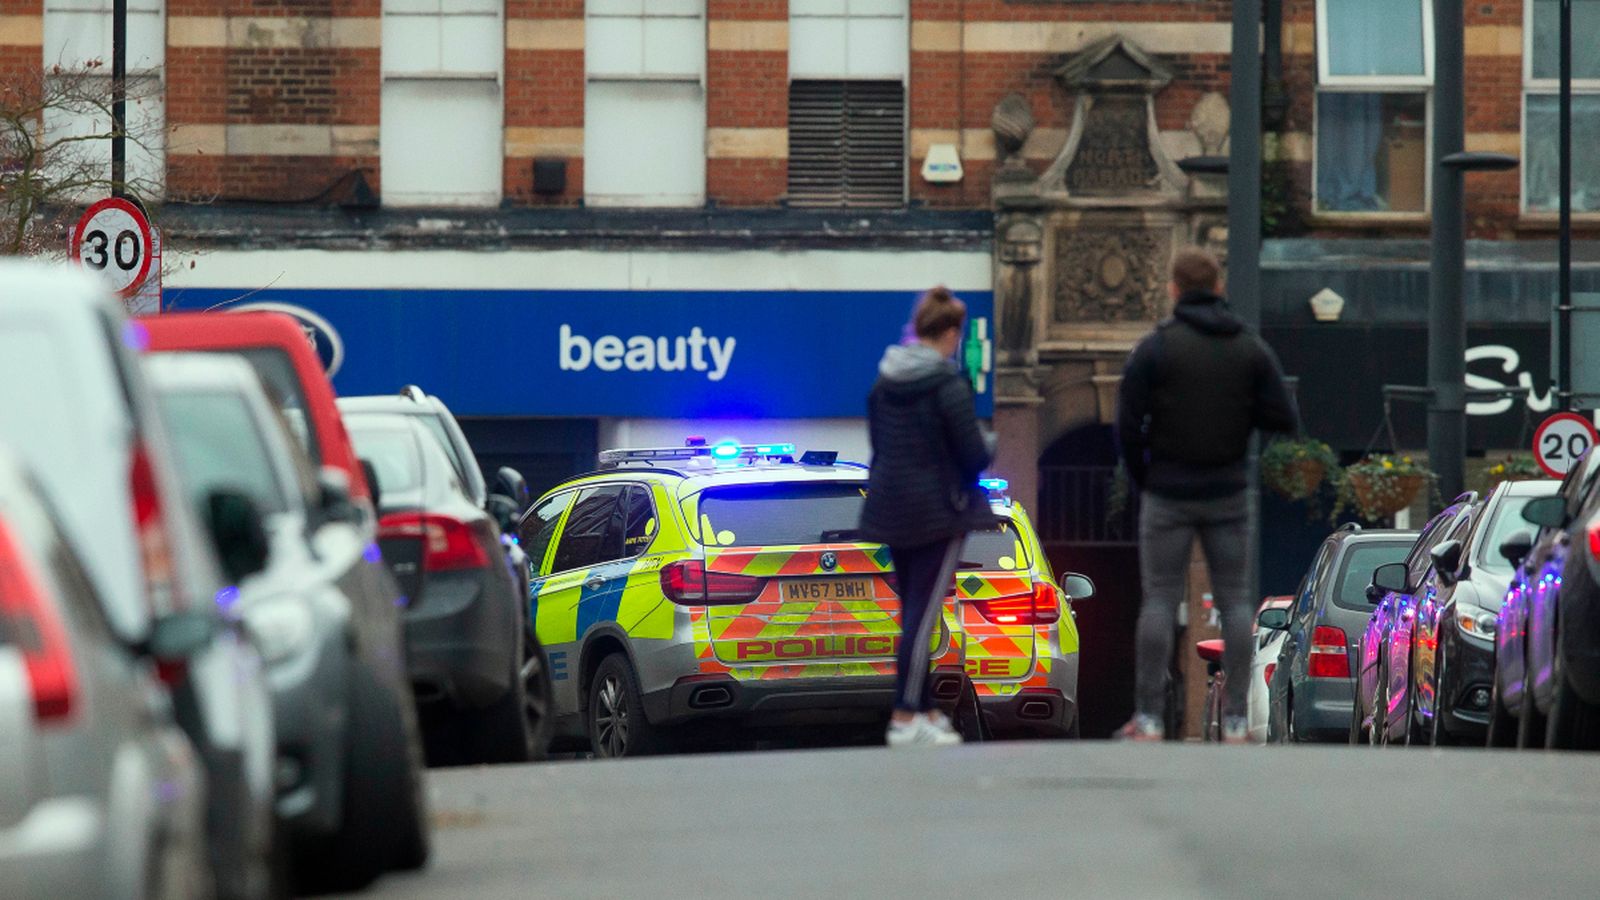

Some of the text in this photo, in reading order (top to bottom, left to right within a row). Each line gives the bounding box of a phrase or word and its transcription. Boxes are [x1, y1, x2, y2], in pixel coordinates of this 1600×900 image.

[84, 229, 141, 271] 30
[559, 323, 737, 382] beauty
[1543, 432, 1589, 460] 20
[788, 581, 866, 599] MV67 BWH
[737, 635, 902, 660] POLIC
